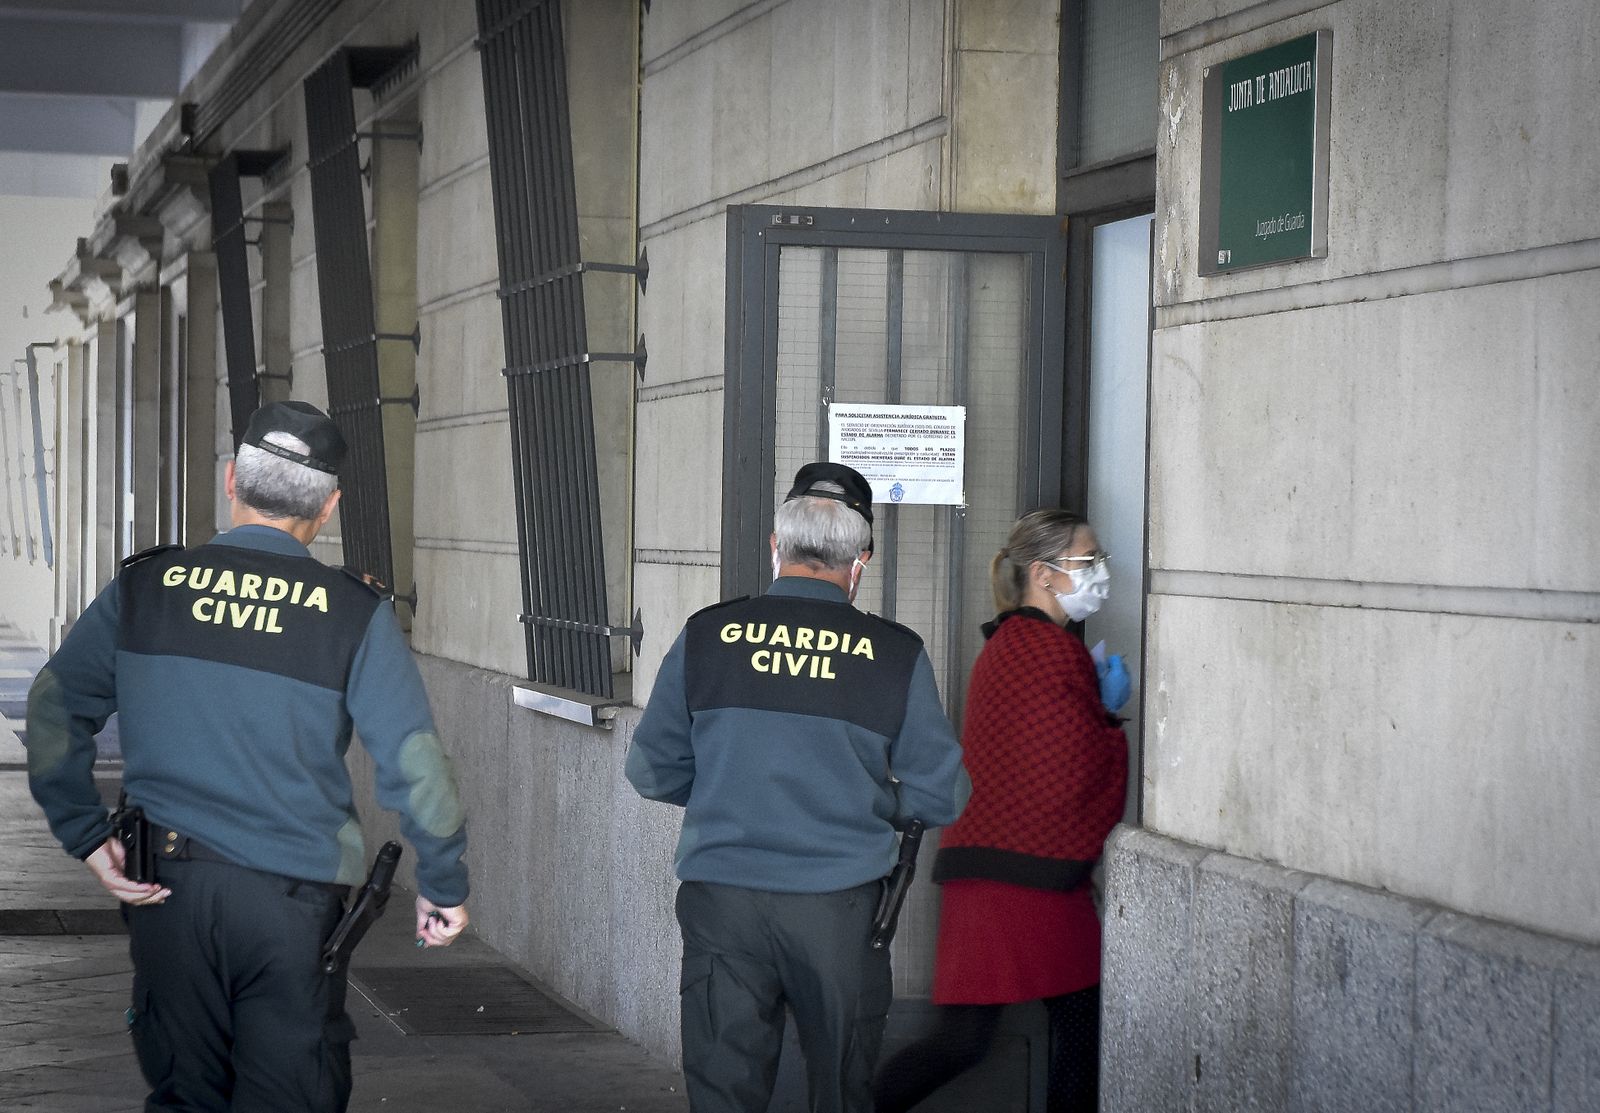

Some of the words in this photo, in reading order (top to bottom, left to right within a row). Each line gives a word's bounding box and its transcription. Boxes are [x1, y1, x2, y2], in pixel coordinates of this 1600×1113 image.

[1229, 79, 1253, 112] JUNTA
[1256, 75, 1266, 104] DE
[1255, 217, 1276, 240] Juzgado
[1277, 216, 1284, 232] de
[1285, 212, 1305, 231] Guardia
[163, 566, 328, 612] GUARDIA
[192, 597, 283, 633] CIVIL
[720, 623, 874, 660] GUARDIA
[751, 650, 836, 679] CIVIL
